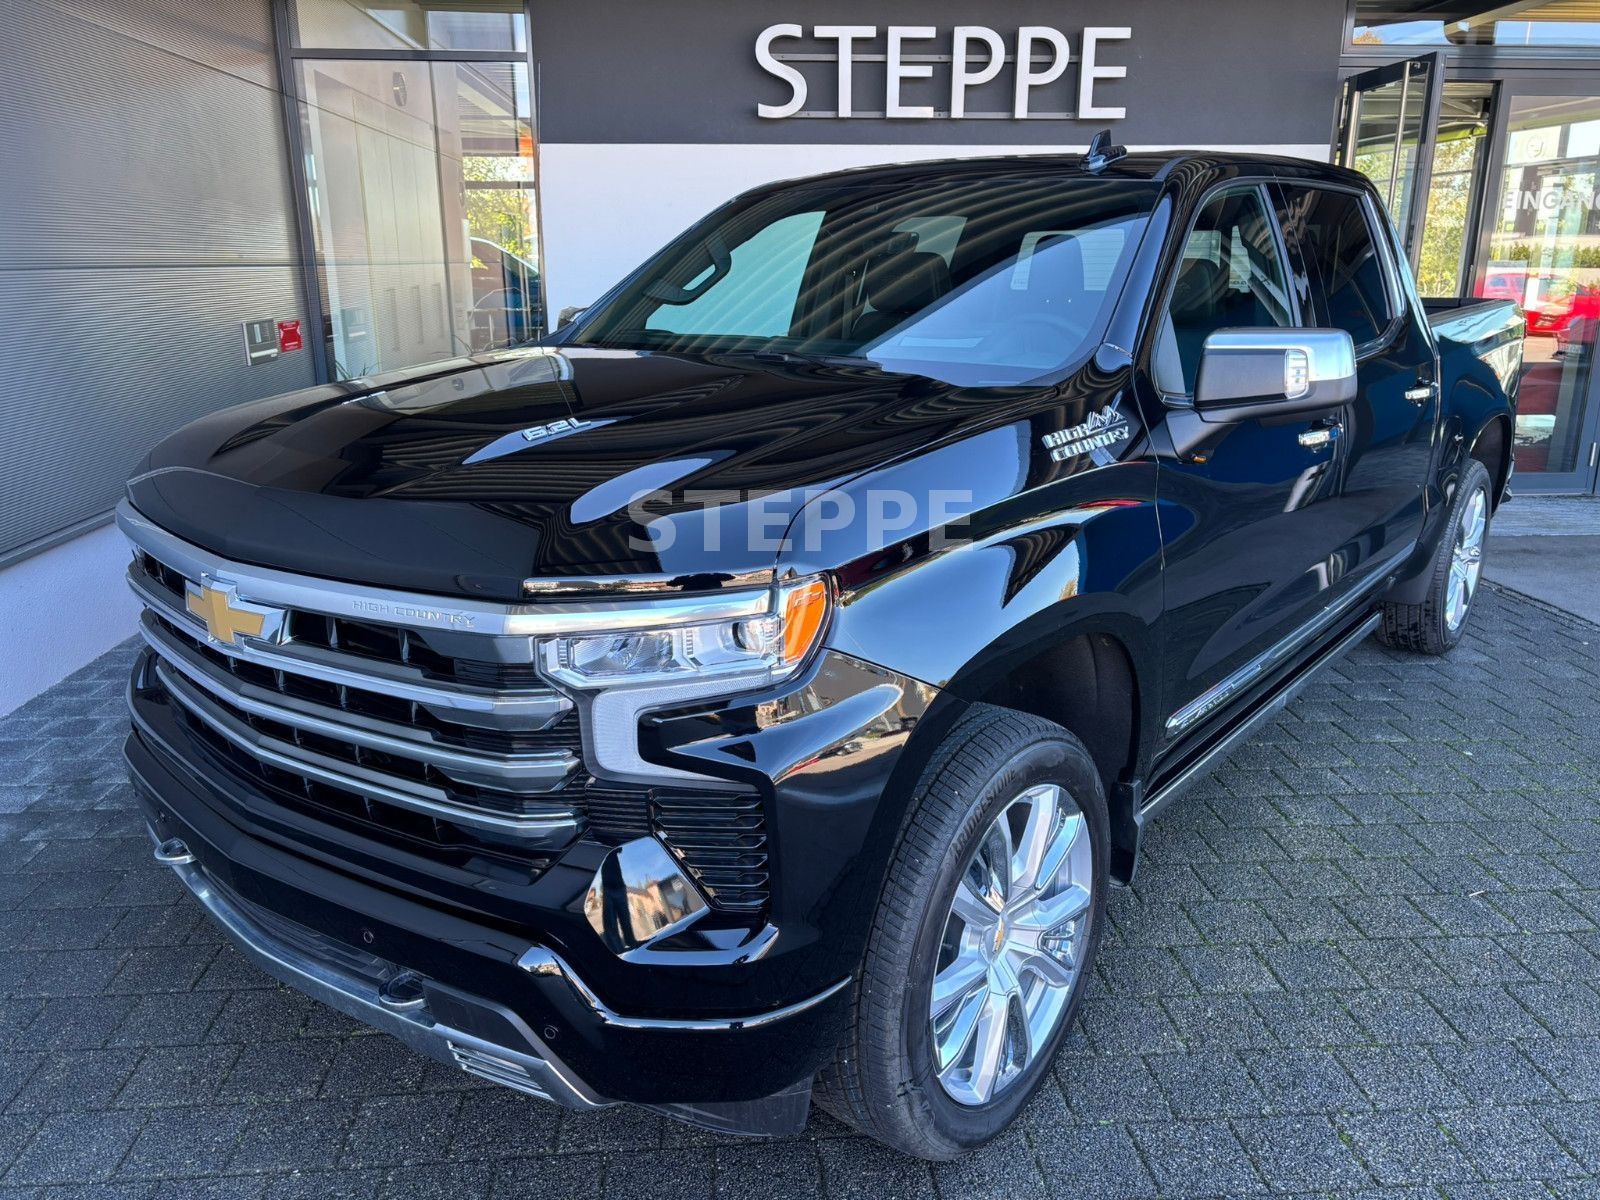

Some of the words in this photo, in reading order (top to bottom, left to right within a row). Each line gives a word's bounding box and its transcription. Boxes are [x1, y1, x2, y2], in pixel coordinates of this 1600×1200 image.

[755, 23, 1132, 119] STEPPE
[1042, 422, 1090, 449] HIGH
[1051, 426, 1129, 463] COUNTRY
[352, 600, 389, 613] HIGH
[394, 606, 475, 625] COUNTRY
